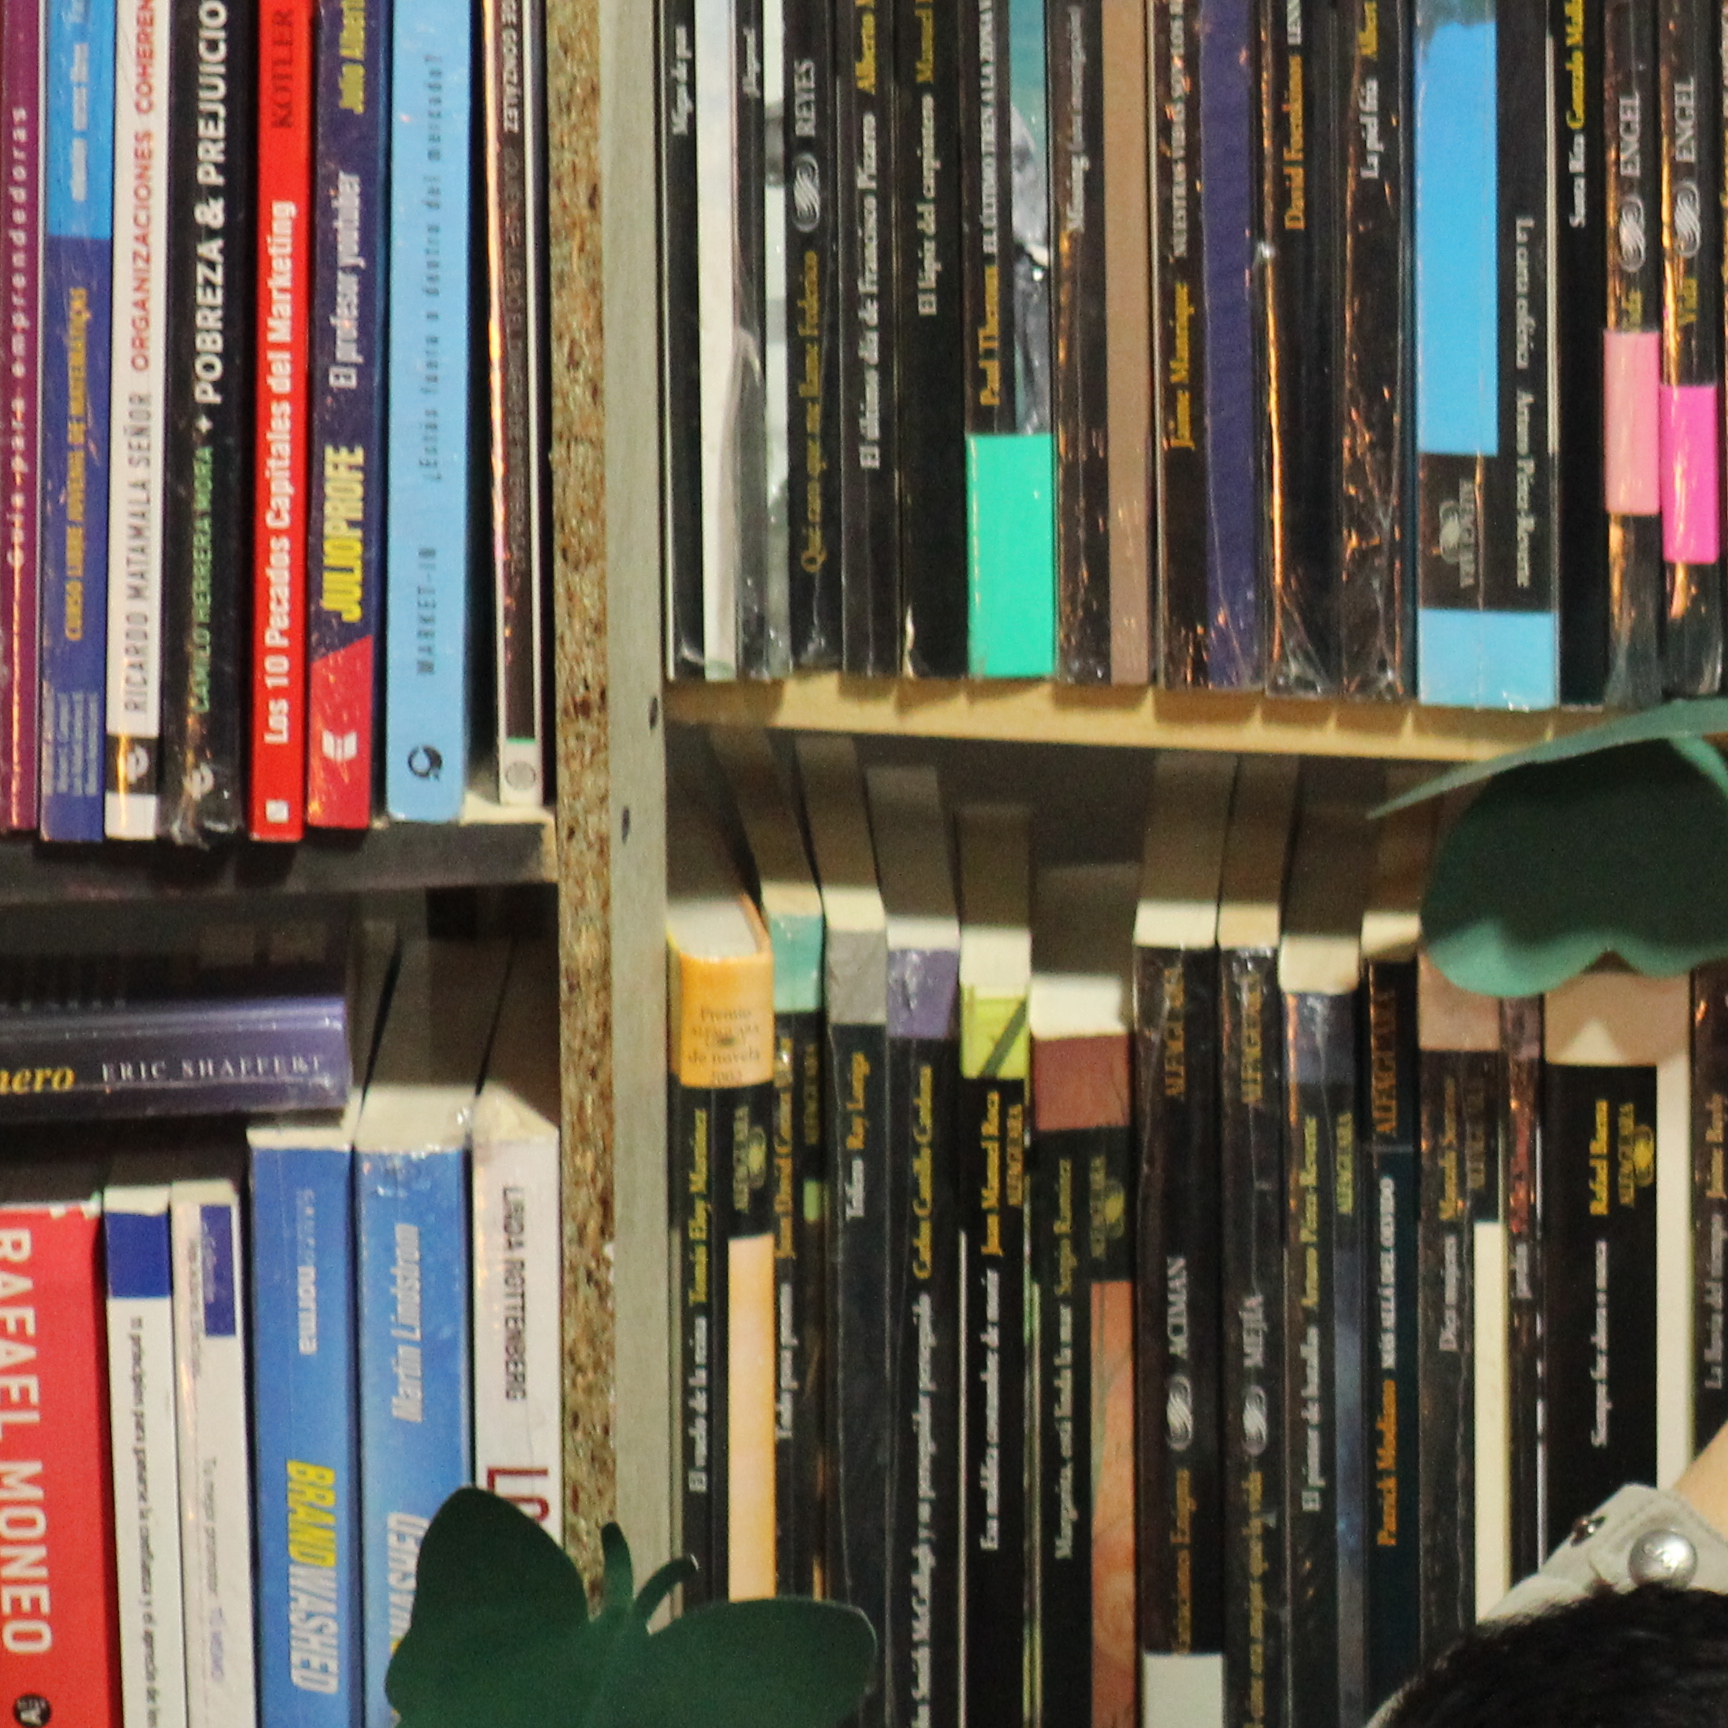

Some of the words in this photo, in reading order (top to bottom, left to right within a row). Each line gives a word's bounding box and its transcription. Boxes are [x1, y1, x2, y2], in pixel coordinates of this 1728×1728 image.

[198, 0, 227, 185] PREJUICIO
[272, 10, 294, 128] KOTLER
[795, 59, 815, 137] REYES
[1620, 91, 1641, 176] ENGEL
[1675, 78, 1695, 162] ENGEL
[197, 196, 224, 228] &
[332, 173, 362, 267] youtuber
[422, 176, 443, 211] del
[8, 106, 28, 377] emprendedoras
[131, 130, 153, 371] ORGANIZACIONES
[266, 202, 297, 342] Marketing
[420, 222, 442, 298] dentro
[196, 240, 224, 403] POBREZA
[330, 272, 364, 363] profesor
[264, 351, 292, 394] del
[330, 371, 357, 388] El
[9, 398, 28, 473] para
[123, 392, 151, 467] SEÑOR
[264, 401, 296, 529] Capitales
[193, 447, 212, 510] MORA
[124, 478, 151, 600] MATAMALA
[191, 516, 211, 622] HERRERA
[324, 446, 364, 622] JULIOPROFE
[264, 536, 290, 645] Pecados
[124, 612, 149, 713] RICARDO
[191, 629, 211, 711] CAMILO
[264, 656, 290, 691] 10
[264, 697, 290, 744] Los
[102, 1059, 167, 1081] ERIC
[500, 1188, 525, 1252] LINDA
[0, 1227, 38, 1426] RAFAEL
[296, 1266, 319, 1355] norma
[391, 1225, 420, 1341] Lindstrom
[500, 1260, 525, 1401] ROTTENBERG
[391, 1346, 422, 1422] Martin
[0, 1461, 51, 1653] MONEO
[287, 1459, 338, 1692] BRANDWASHED
